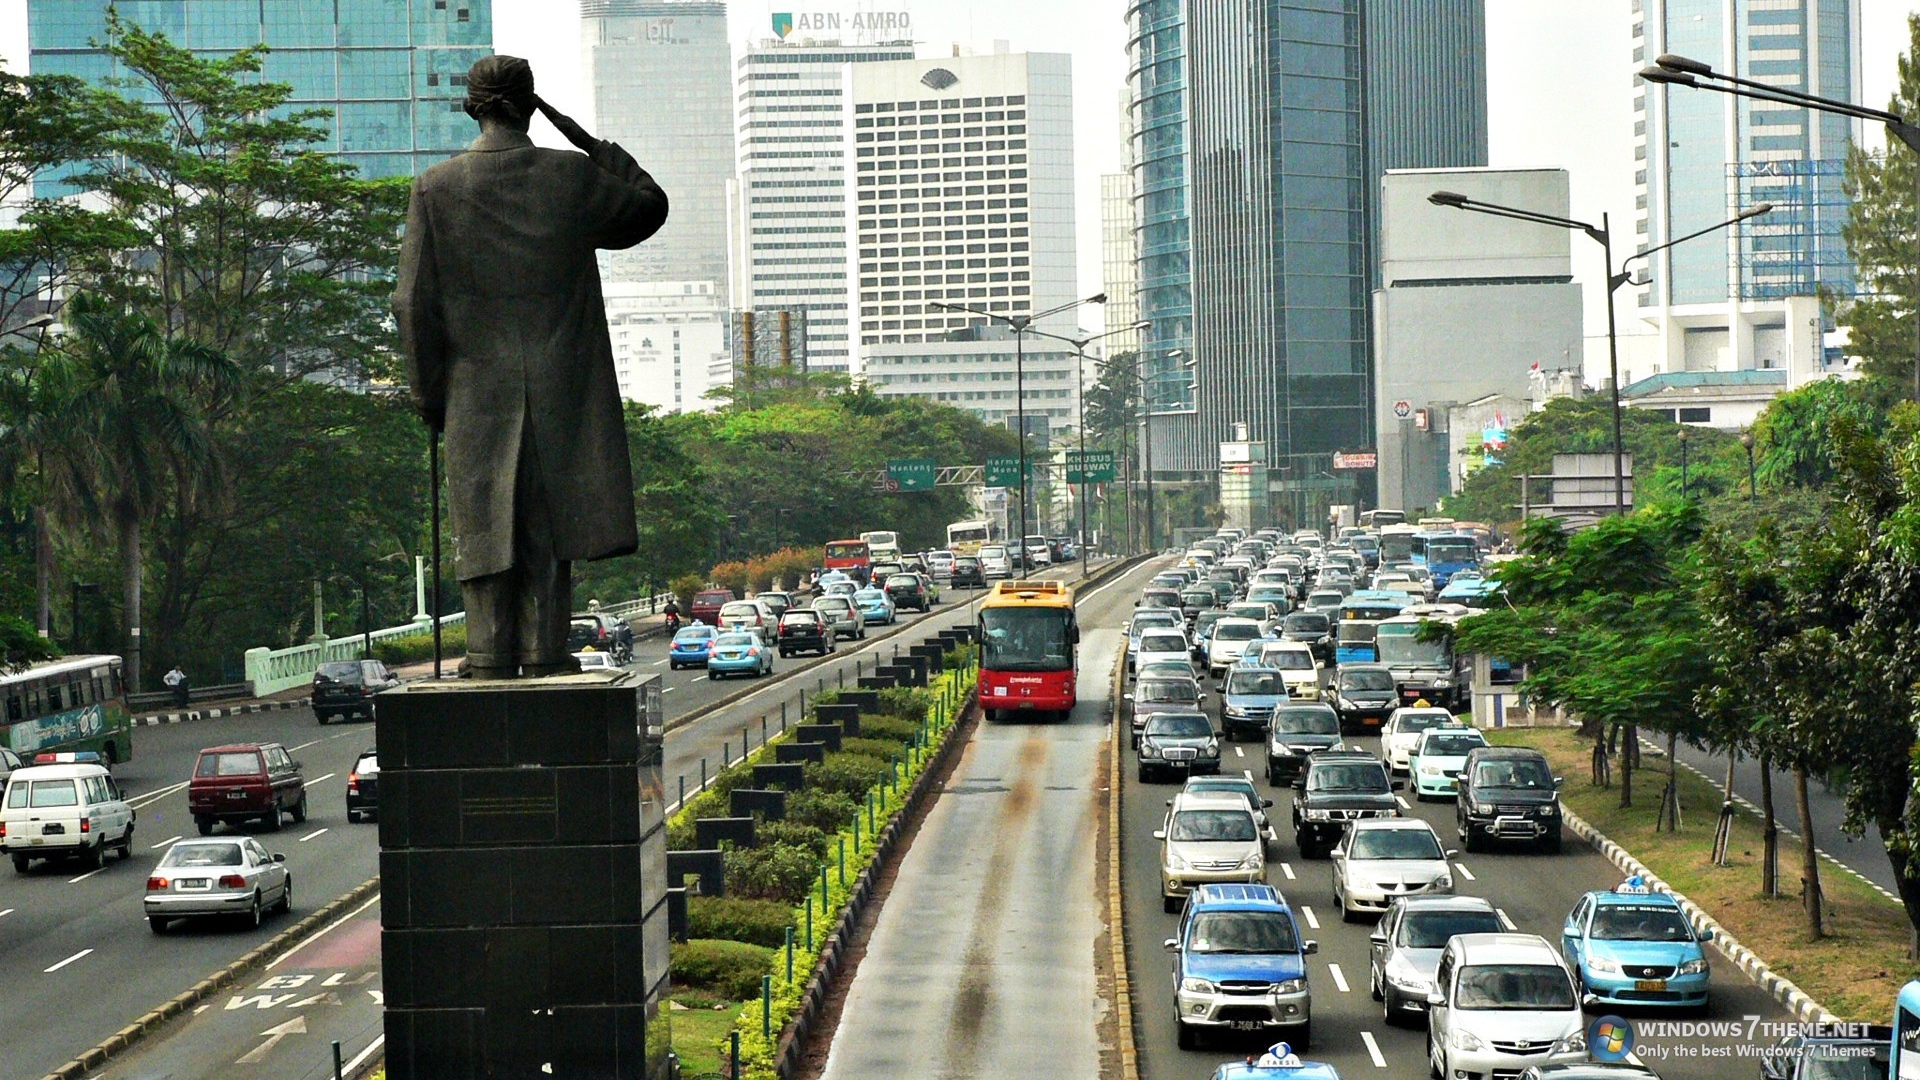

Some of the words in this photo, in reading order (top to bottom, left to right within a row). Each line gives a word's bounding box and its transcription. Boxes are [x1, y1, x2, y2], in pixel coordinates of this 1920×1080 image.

[1067, 455, 1111, 463] KHUSUS
[1067, 463, 1111, 472] BUSWAY
[257, 971, 378, 990] BU
